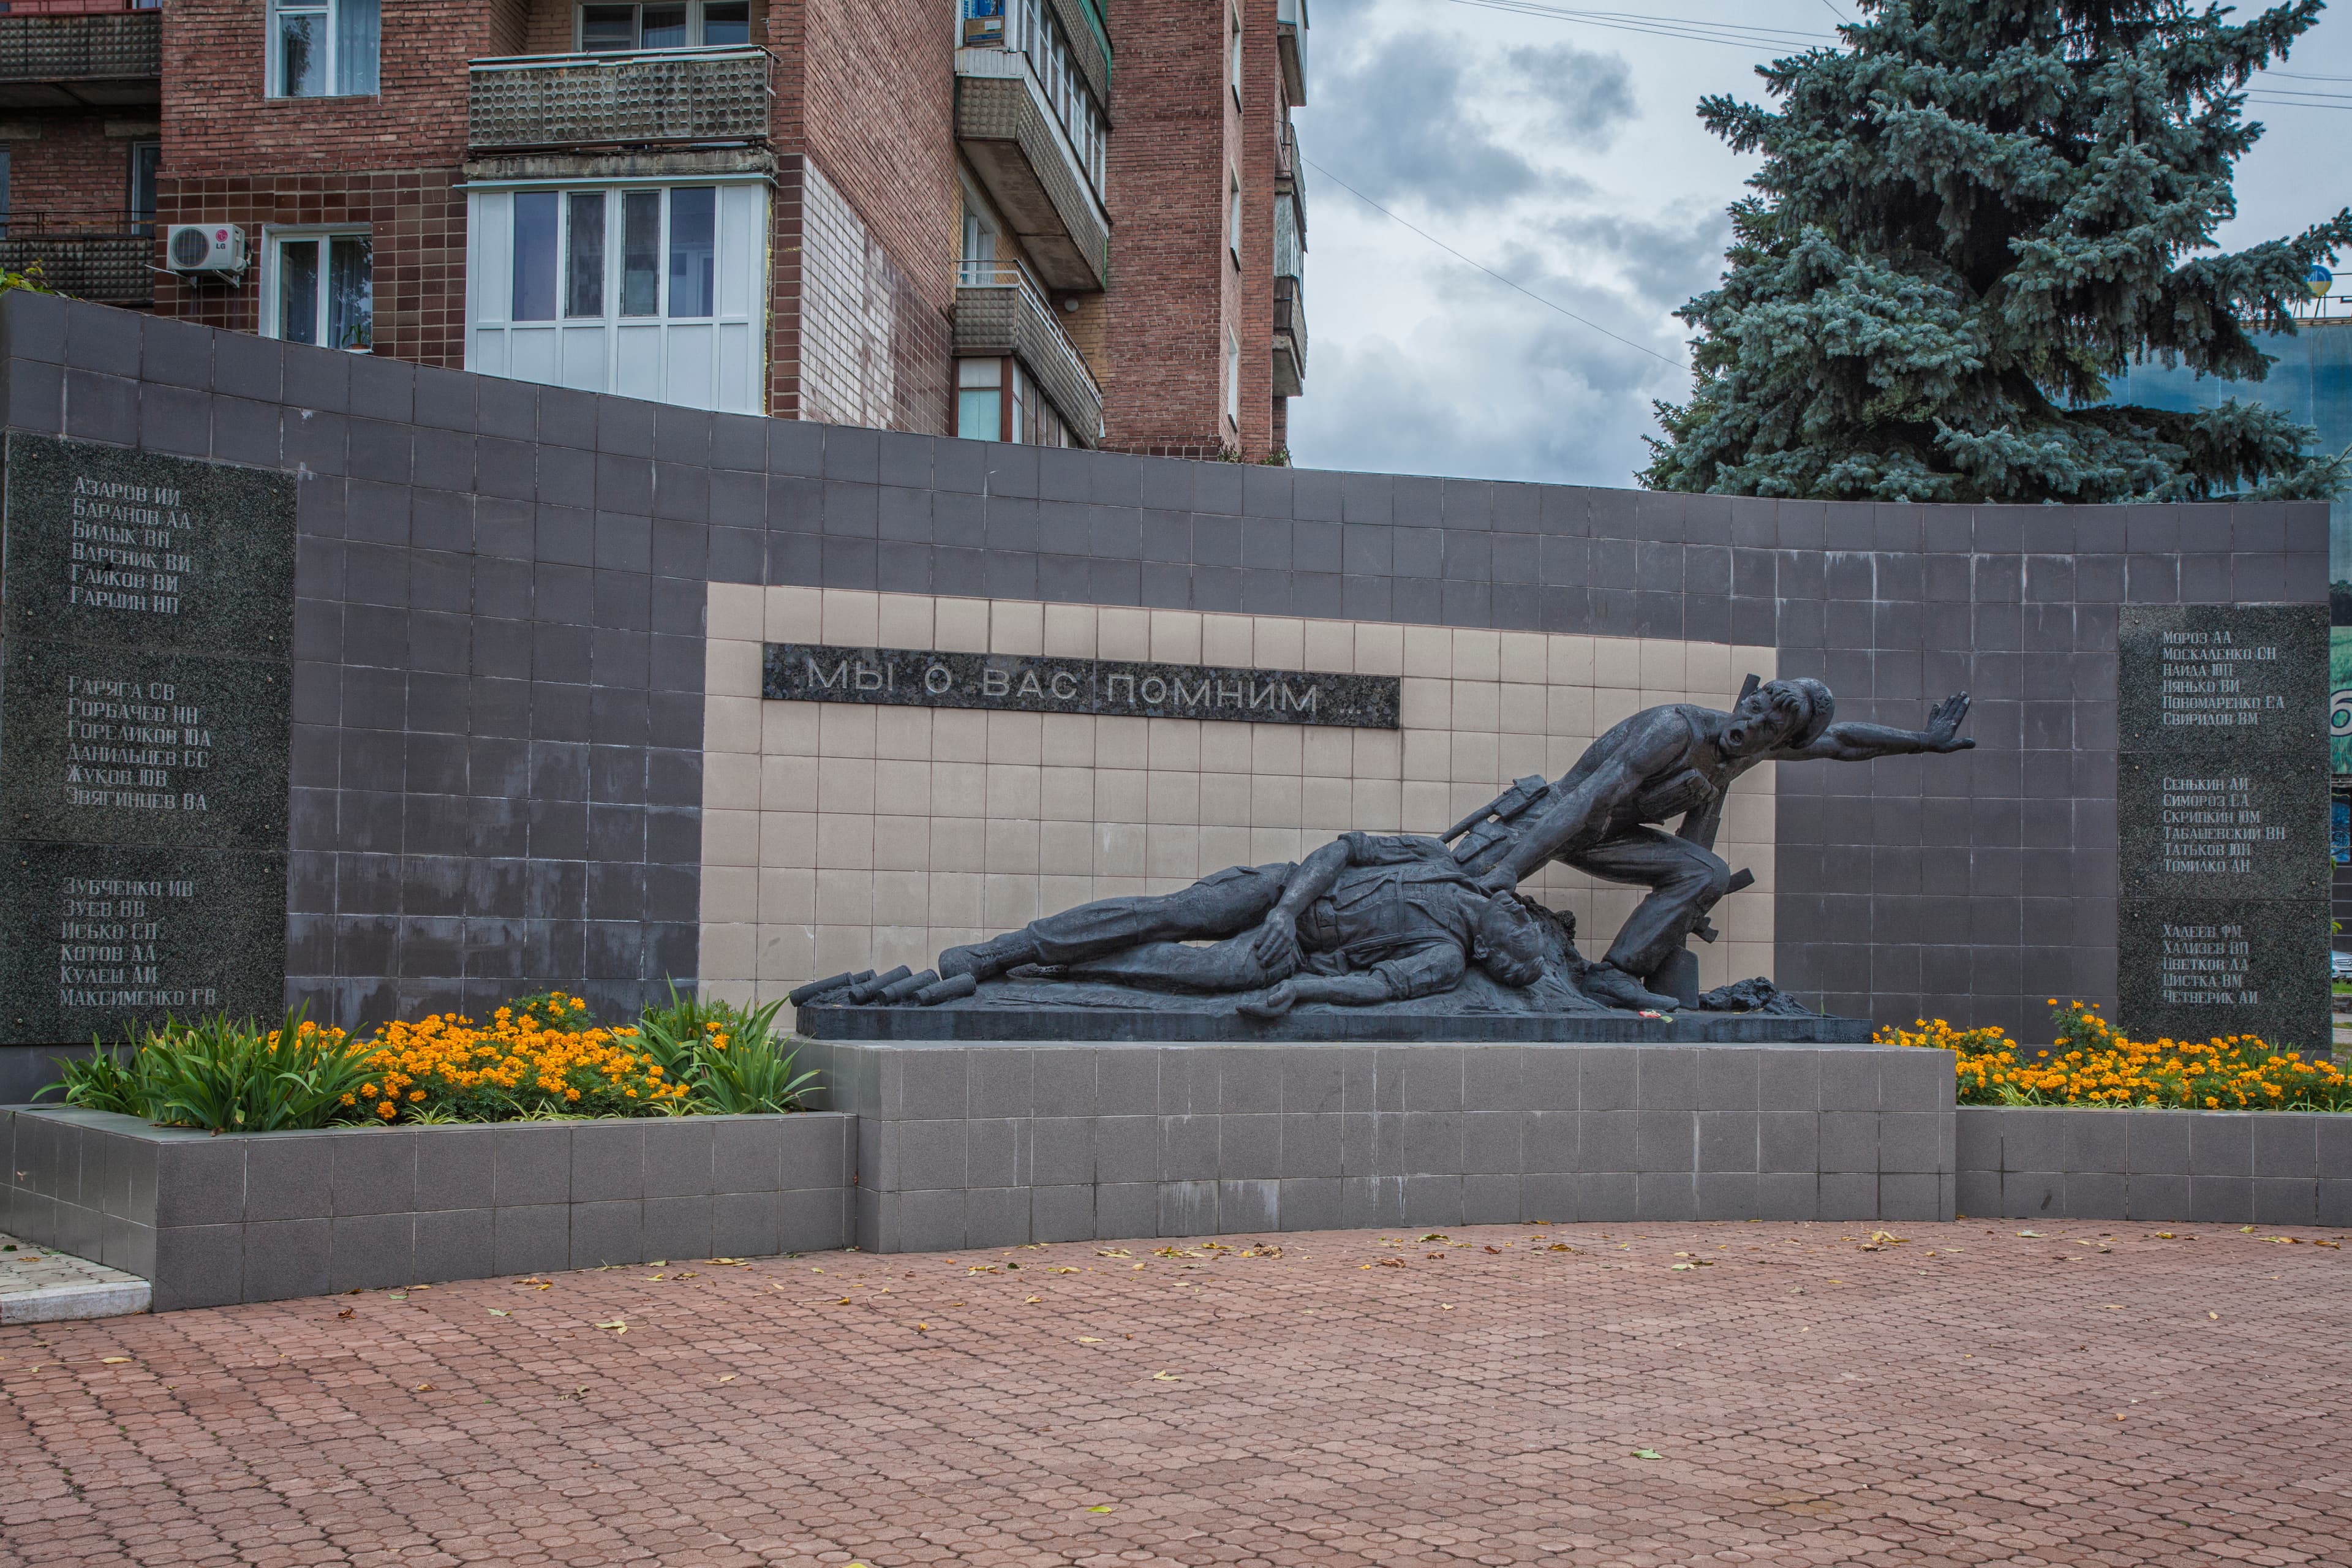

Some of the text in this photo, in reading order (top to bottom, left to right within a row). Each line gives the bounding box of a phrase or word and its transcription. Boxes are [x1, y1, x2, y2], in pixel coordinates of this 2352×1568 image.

[73, 476, 181, 507] АЗАРОВ ИИ
[73, 497, 190, 530] БАРАНОВ АА
[72, 519, 170, 548] БИЛЫК ВП
[72, 542, 191, 573] ВАРЕНИК ВИ
[70, 586, 179, 614] ГАРШИН НП
[2163, 631, 2232, 644] МОРОЗ АА
[2163, 647, 2277, 660] МОСКАЛЕНКО СН
[807, 657, 893, 692] МЫ
[924, 665, 952, 693] О
[983, 668, 1078, 699] ВАС
[2212, 663, 2233, 676] ЮП
[68, 676, 175, 701] ГАРЯГА СВ
[2163, 679, 2240, 693] НЯНЬКО ВИ
[68, 698, 198, 724] ГОРБАЧЕВ НН
[2163, 696, 2285, 709] ПОНОМАРЕНКО ЕА
[2163, 712, 2258, 726] СВИРИДОВ ВМ
[67, 720, 211, 747] ГОРЕЛИКОВ ЮА
[67, 742, 209, 768] ДАНИЛЬЦЕВ СС
[67, 764, 167, 786] ЖУКОВ ЮВ
[2163, 777, 2248, 791] СЕНЬКИН АИ
[66, 787, 207, 811] ЗВЯГИНЦЕВ ВА
[2163, 794, 2225, 807] СИМОРОЗ
[2238, 810, 2260, 823] ЮМ
[2266, 827, 2285, 840] ВН
[2163, 843, 2251, 856] ТАТЬКОВ ЮН
[2163, 859, 2250, 872] ТОМИЛКО АН
[63, 877, 193, 897] ЗУБЧЕНКО ИВ
[63, 899, 145, 918] ЗУЕВ ВВ
[61, 921, 157, 940] ИСЬКО СП
[2221, 925, 2242, 938] ФМ
[61, 944, 156, 962] КОТОВ АА
[2163, 941, 2249, 954] ХАЛИЗЕВ ВП
[2163, 957, 2225, 971] ЦВЕТКОВ
[61, 966, 157, 984] КУЛЕШ АИ
[2163, 973, 2242, 987] ШИСТКА ВМ
[59, 989, 216, 1006] МАКСИМЕНКО ГВ
[2162, 990, 2258, 1004] ЧЕТВЕРИК АИ
